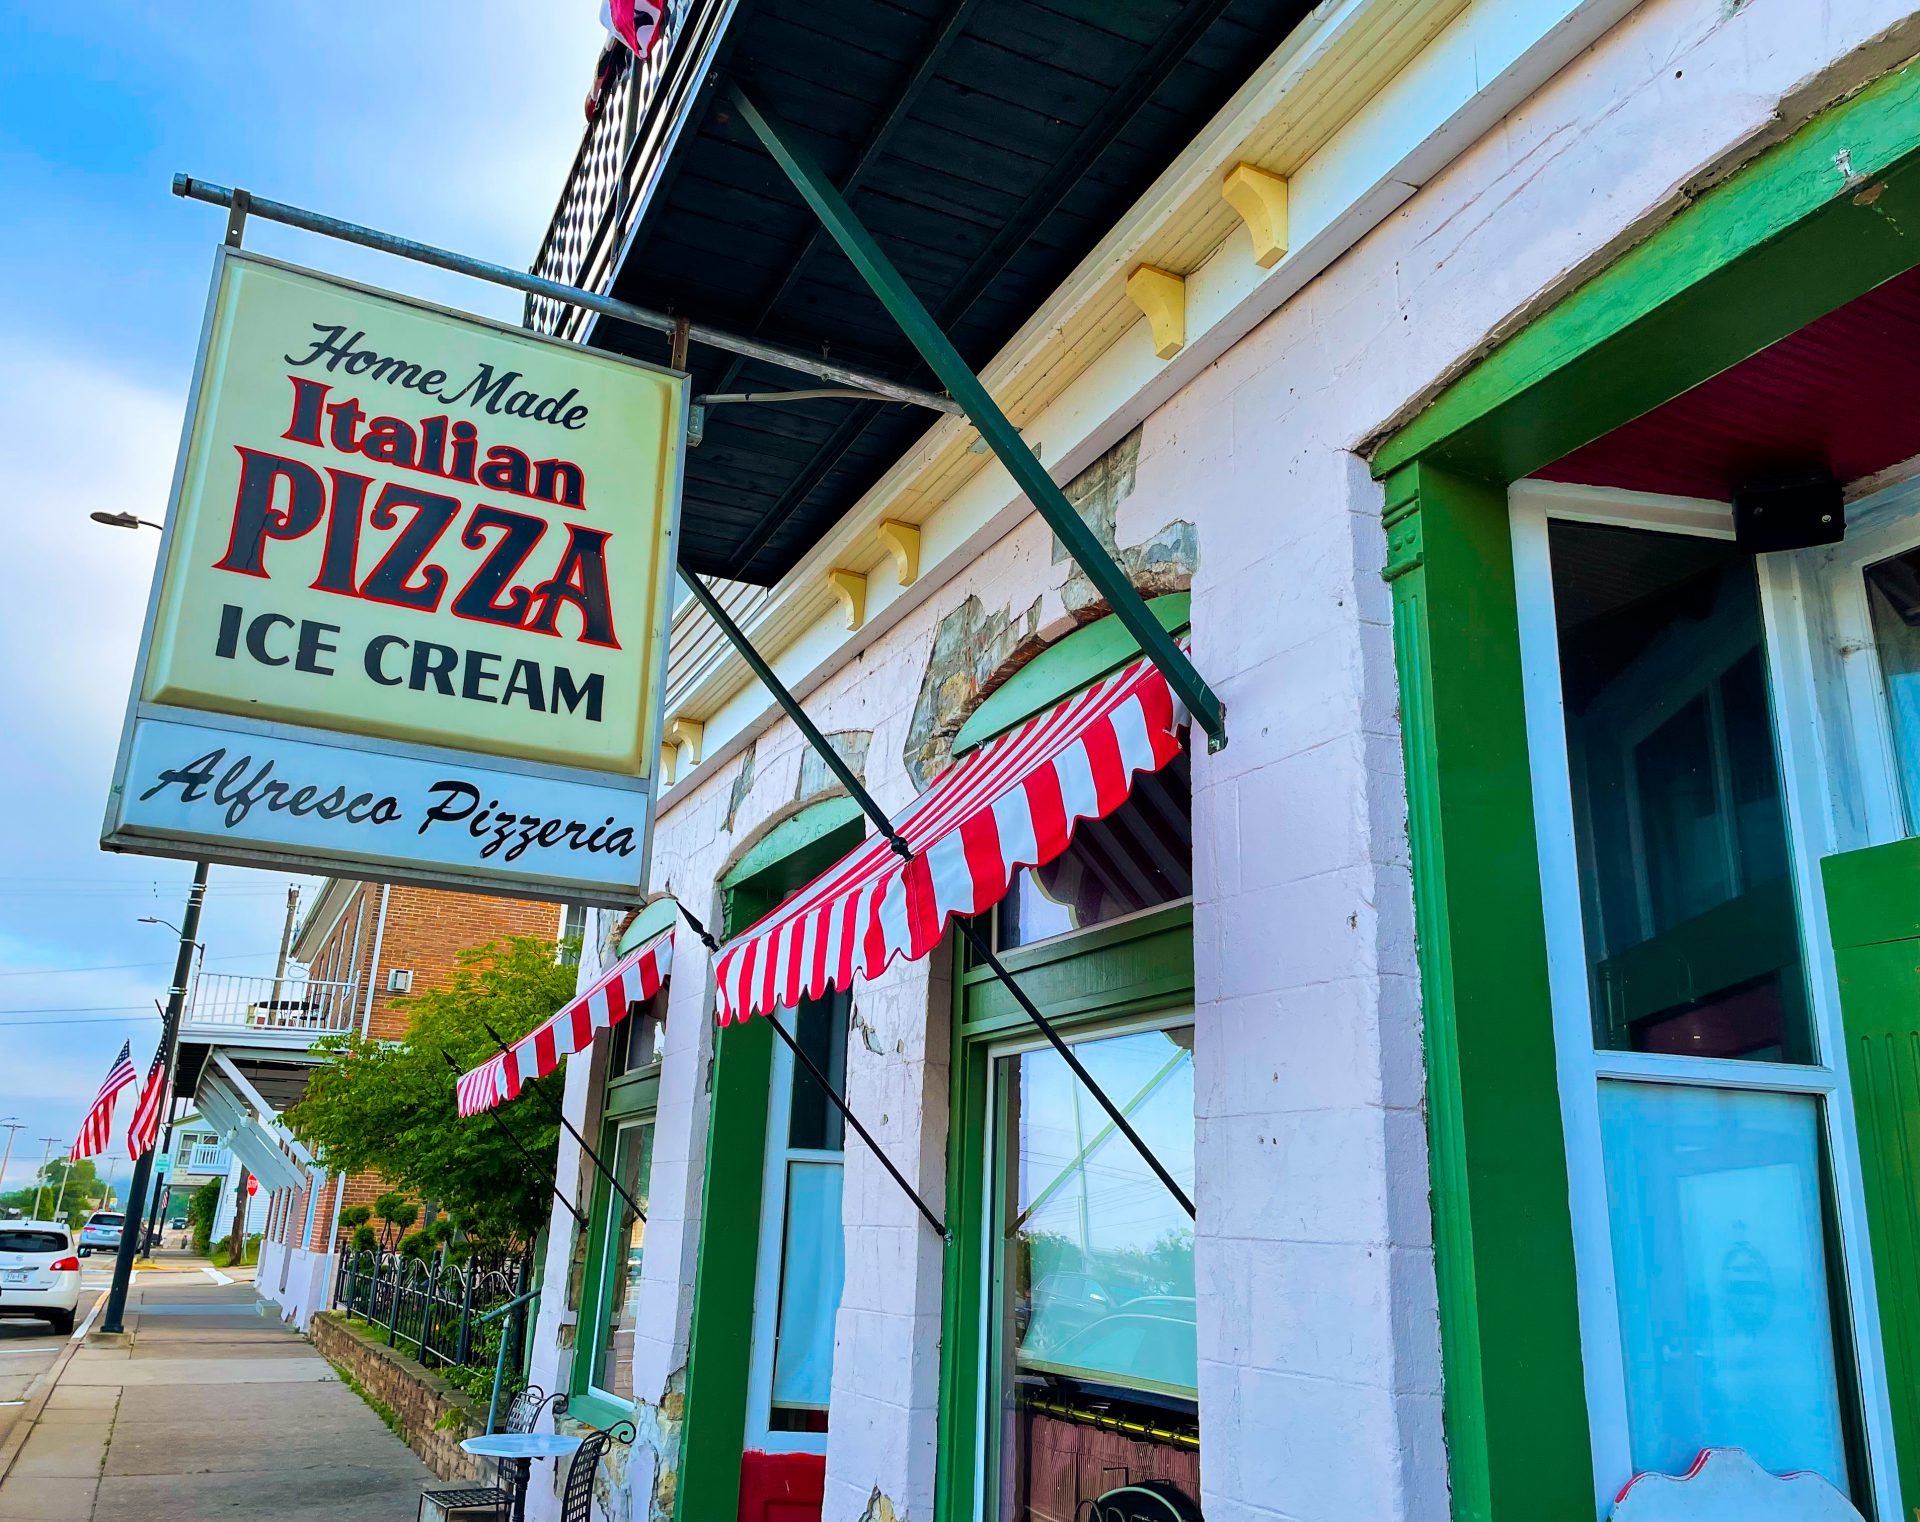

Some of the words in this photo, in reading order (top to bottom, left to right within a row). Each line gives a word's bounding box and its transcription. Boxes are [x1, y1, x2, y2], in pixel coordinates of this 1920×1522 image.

[283, 322, 447, 395] Home
[437, 362, 589, 431] Made
[280, 375, 587, 511] Italian
[211, 444, 623, 650] PIZZA
[215, 603, 341, 677] ICE
[363, 634, 606, 723] CREAM
[139, 747, 402, 829] Alfresco
[418, 780, 638, 862] Pizzeria
